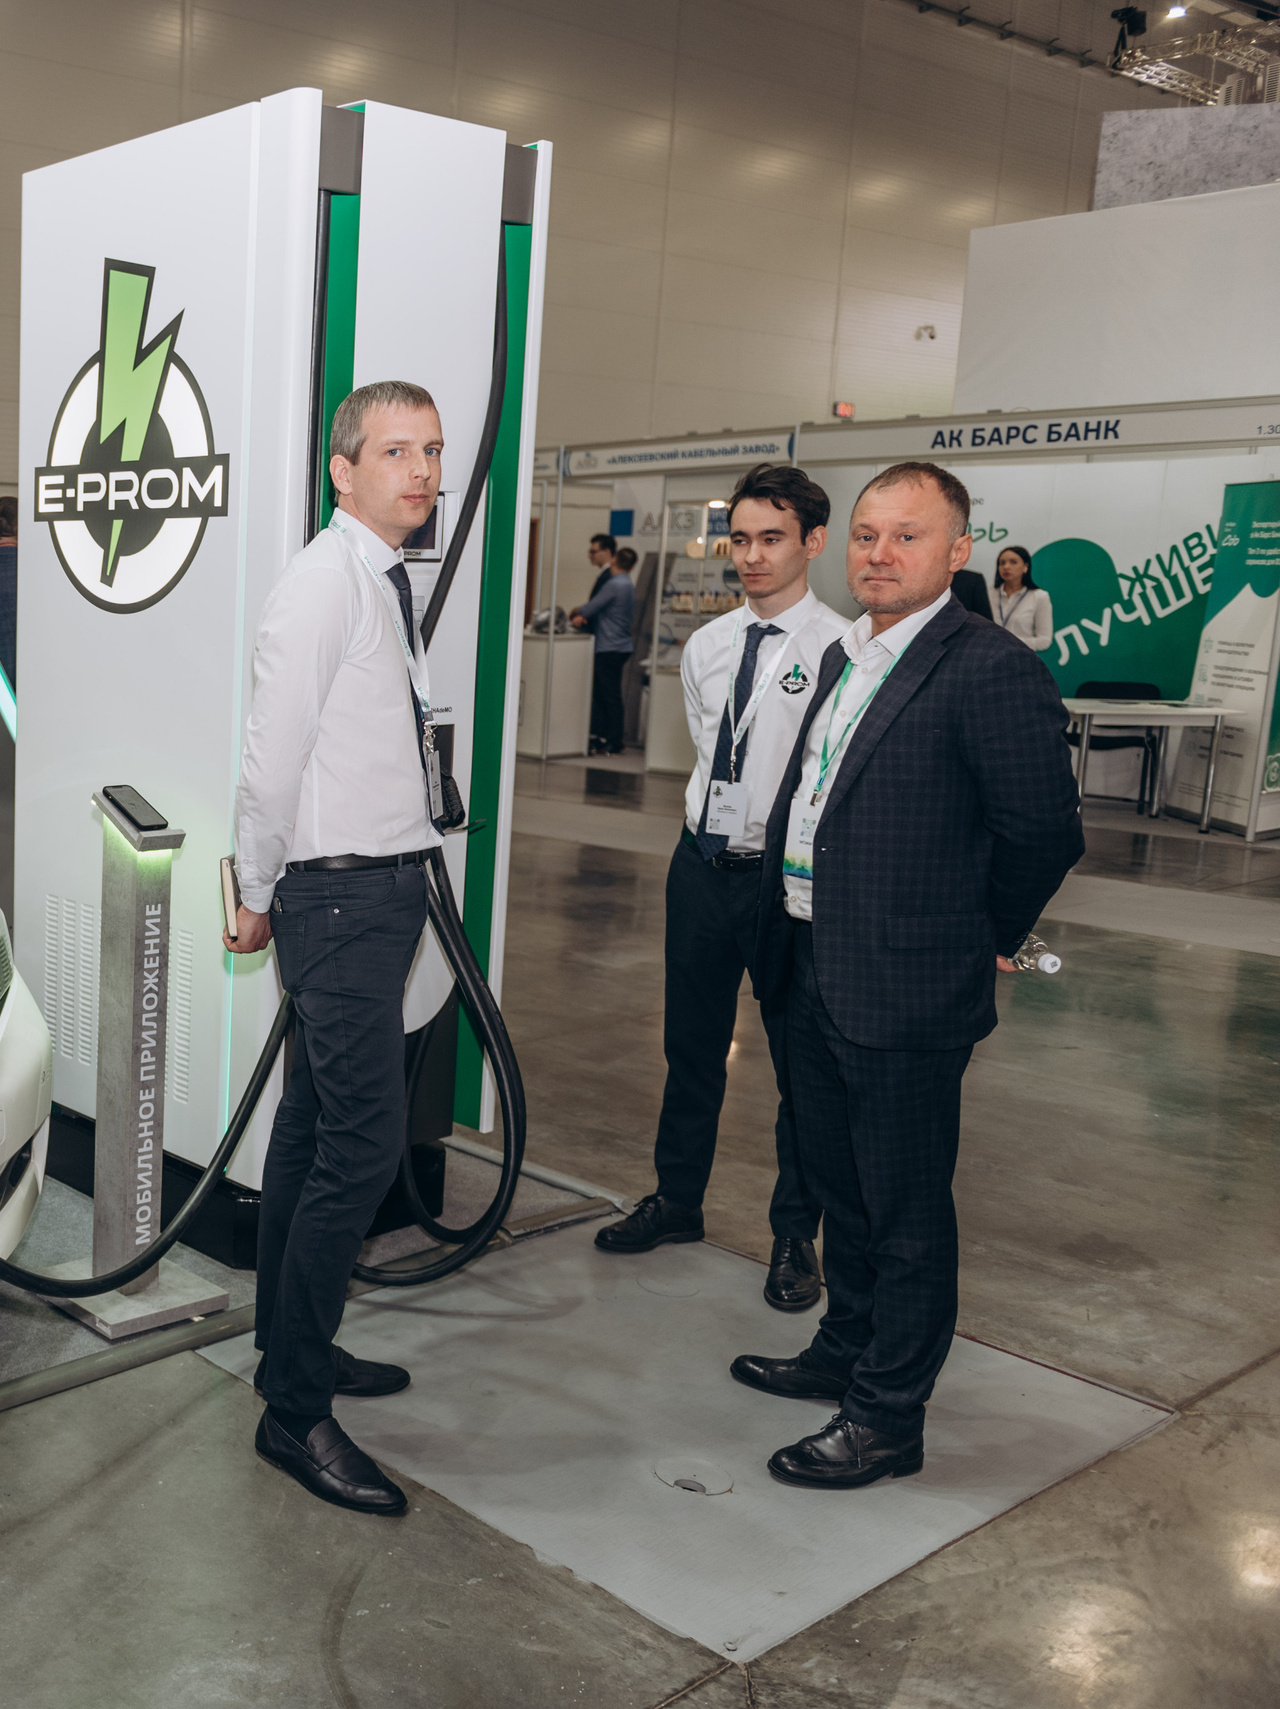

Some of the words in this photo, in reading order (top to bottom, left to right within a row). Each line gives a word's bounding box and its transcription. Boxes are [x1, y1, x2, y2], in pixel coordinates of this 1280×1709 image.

[681, 445, 740, 459] КАБЕЛЬНЫЙ
[931, 429, 963, 449] АК
[971, 424, 1039, 447] БАРС
[1046, 419, 1120, 443] БАНК
[38, 465, 223, 513] E-PROM
[1054, 552, 1214, 667] ЛУЧШЕ
[140, 902, 162, 1082] ПРИЛОЖЕНИЕ
[135, 1087, 155, 1246] МОБИЛЬНОЕ
